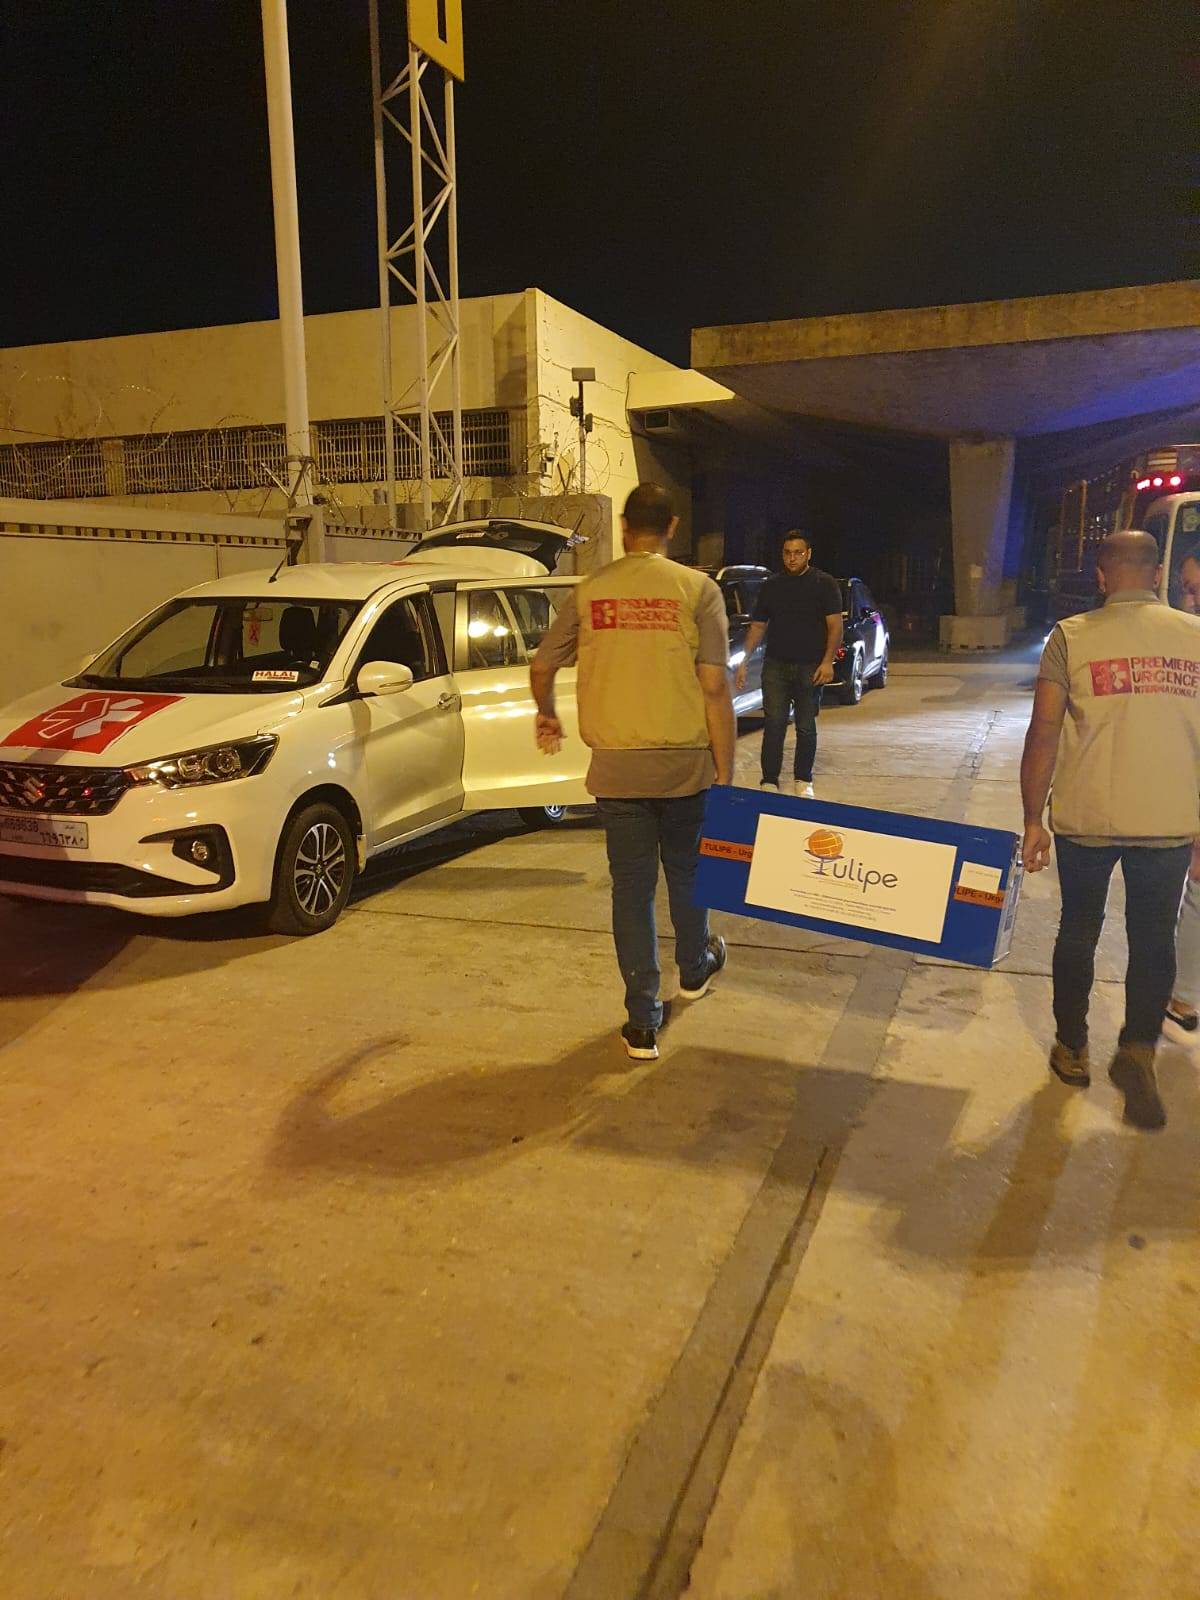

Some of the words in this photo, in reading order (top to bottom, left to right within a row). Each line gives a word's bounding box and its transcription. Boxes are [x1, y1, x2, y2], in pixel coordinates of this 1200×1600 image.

[1132, 670, 1200, 688] URGENCE
[704, 842, 732, 854] TULIPE
[954, 886, 976, 898] LIPE
